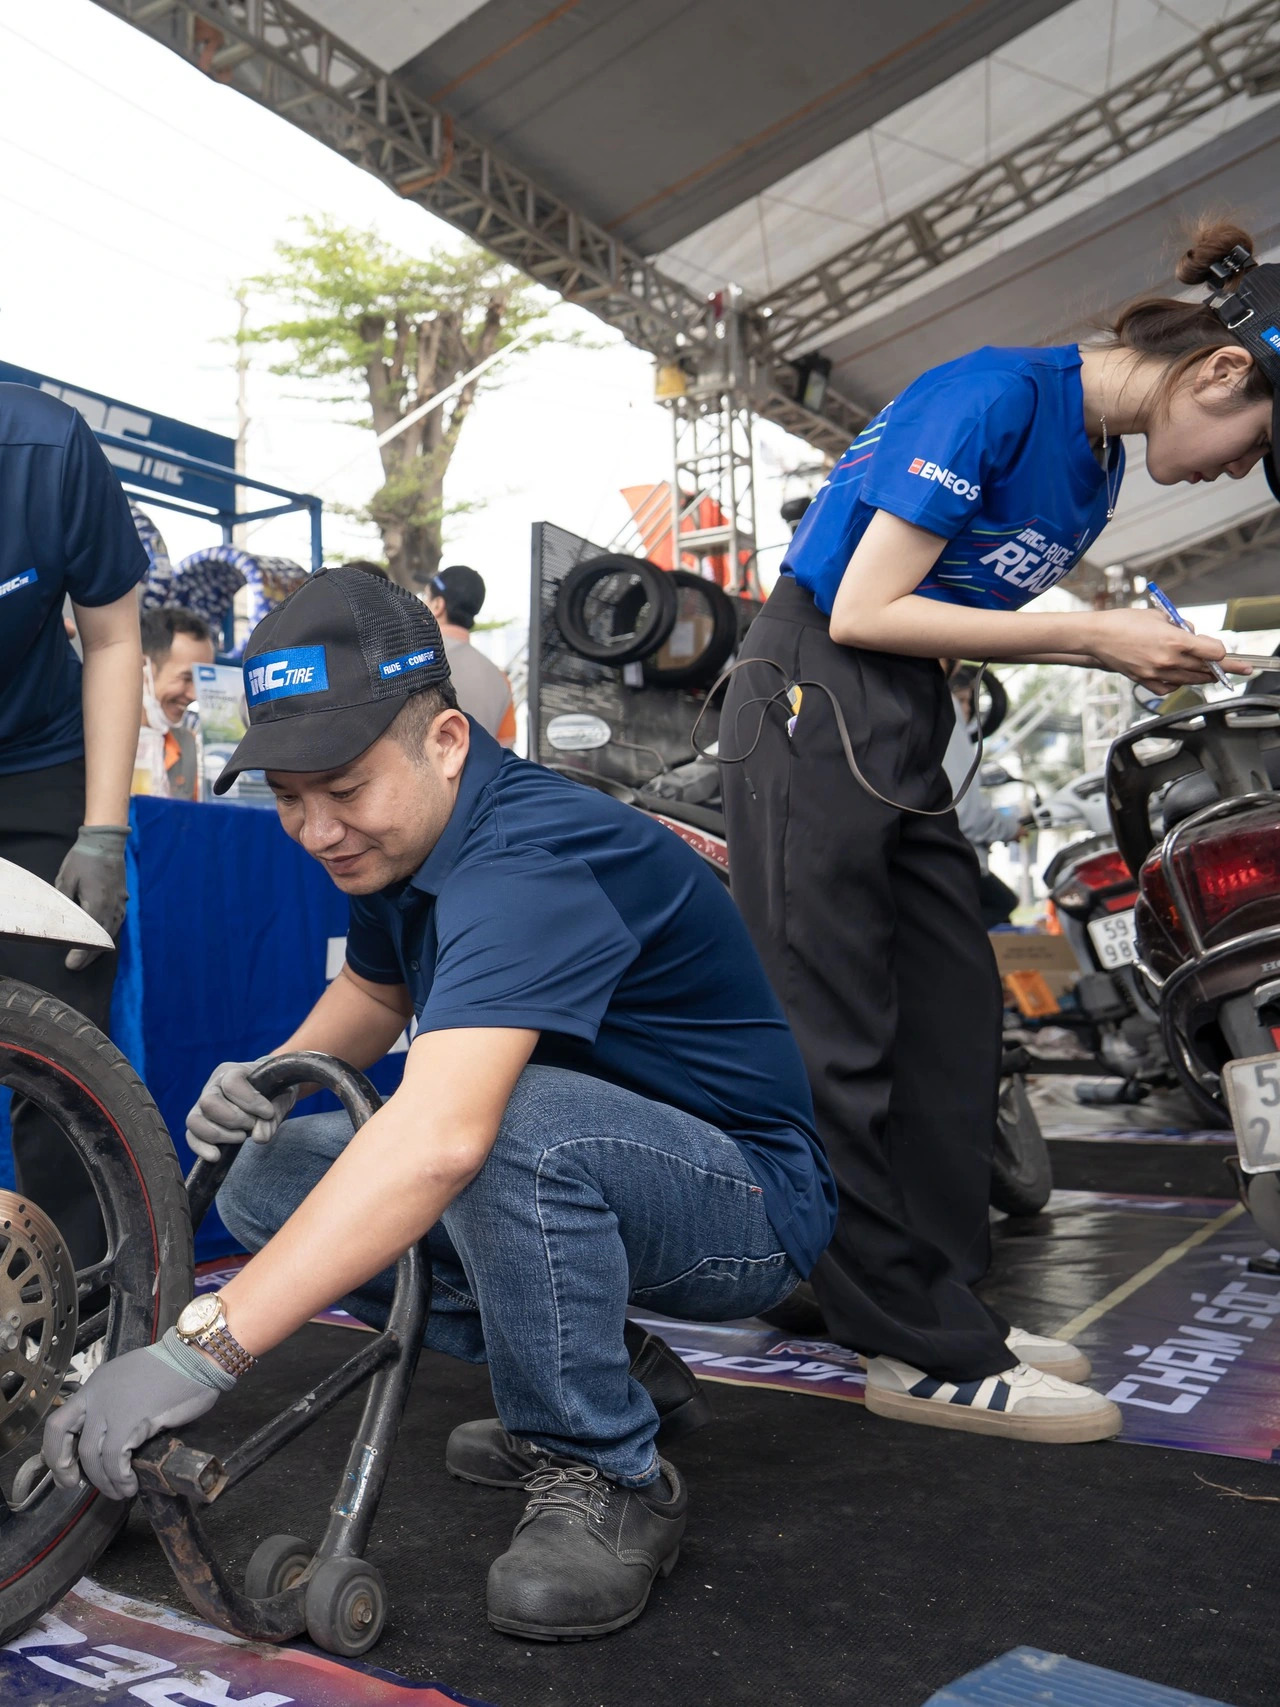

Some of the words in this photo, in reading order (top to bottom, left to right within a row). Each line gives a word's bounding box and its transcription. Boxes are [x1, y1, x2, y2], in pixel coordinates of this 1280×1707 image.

[920, 461, 981, 501] ENEOS
[1042, 542, 1075, 567] RIDE
[979, 541, 1069, 594] READ
[285, 667, 315, 684] TIRE
[383, 661, 402, 675] RIDE
[1104, 918, 1129, 940] 59
[1105, 940, 1132, 962] 98
[1104, 1325, 1255, 1414] CHĂM
